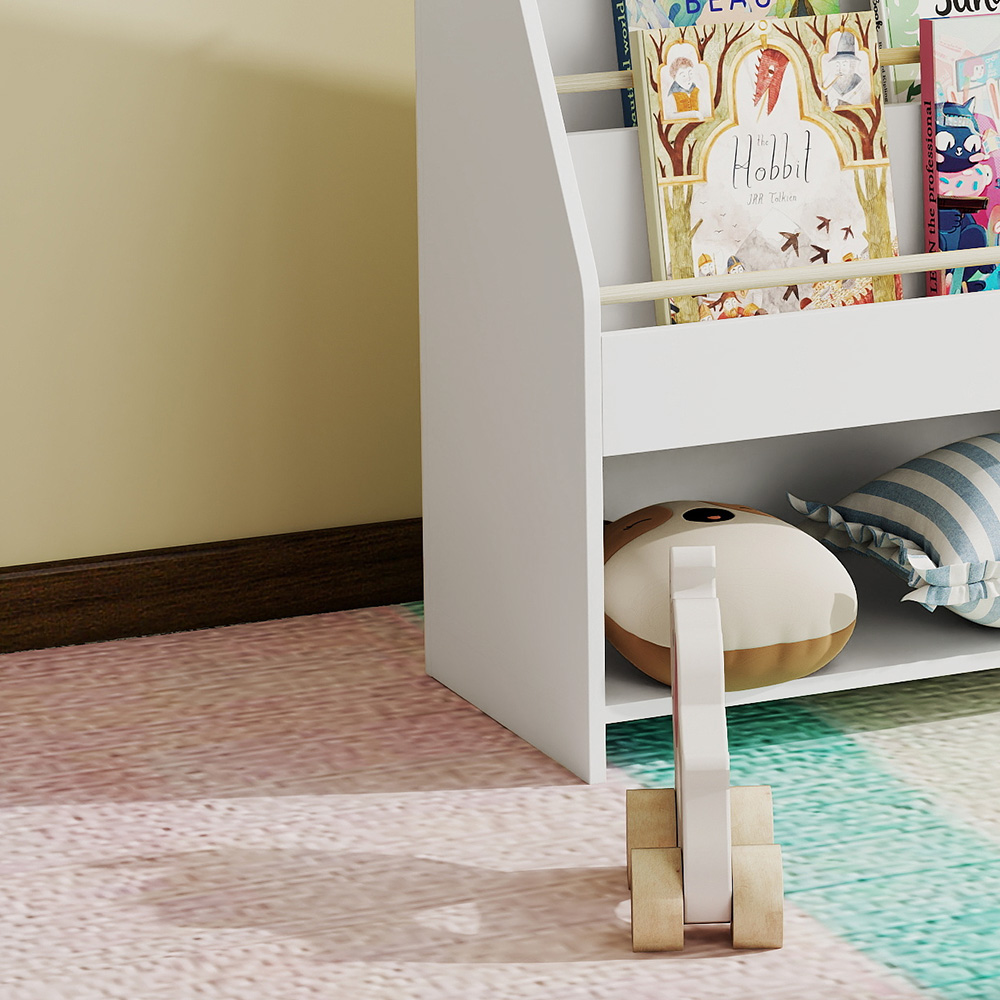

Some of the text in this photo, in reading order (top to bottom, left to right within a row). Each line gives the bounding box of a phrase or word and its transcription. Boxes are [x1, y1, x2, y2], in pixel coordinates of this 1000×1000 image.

[616, 0, 629, 55] world
[733, 130, 812, 189] Hobbit
[757, 134, 769, 146] the
[769, 192, 797, 203] Tolkien
[924, 101, 938, 295] LEN the professional
